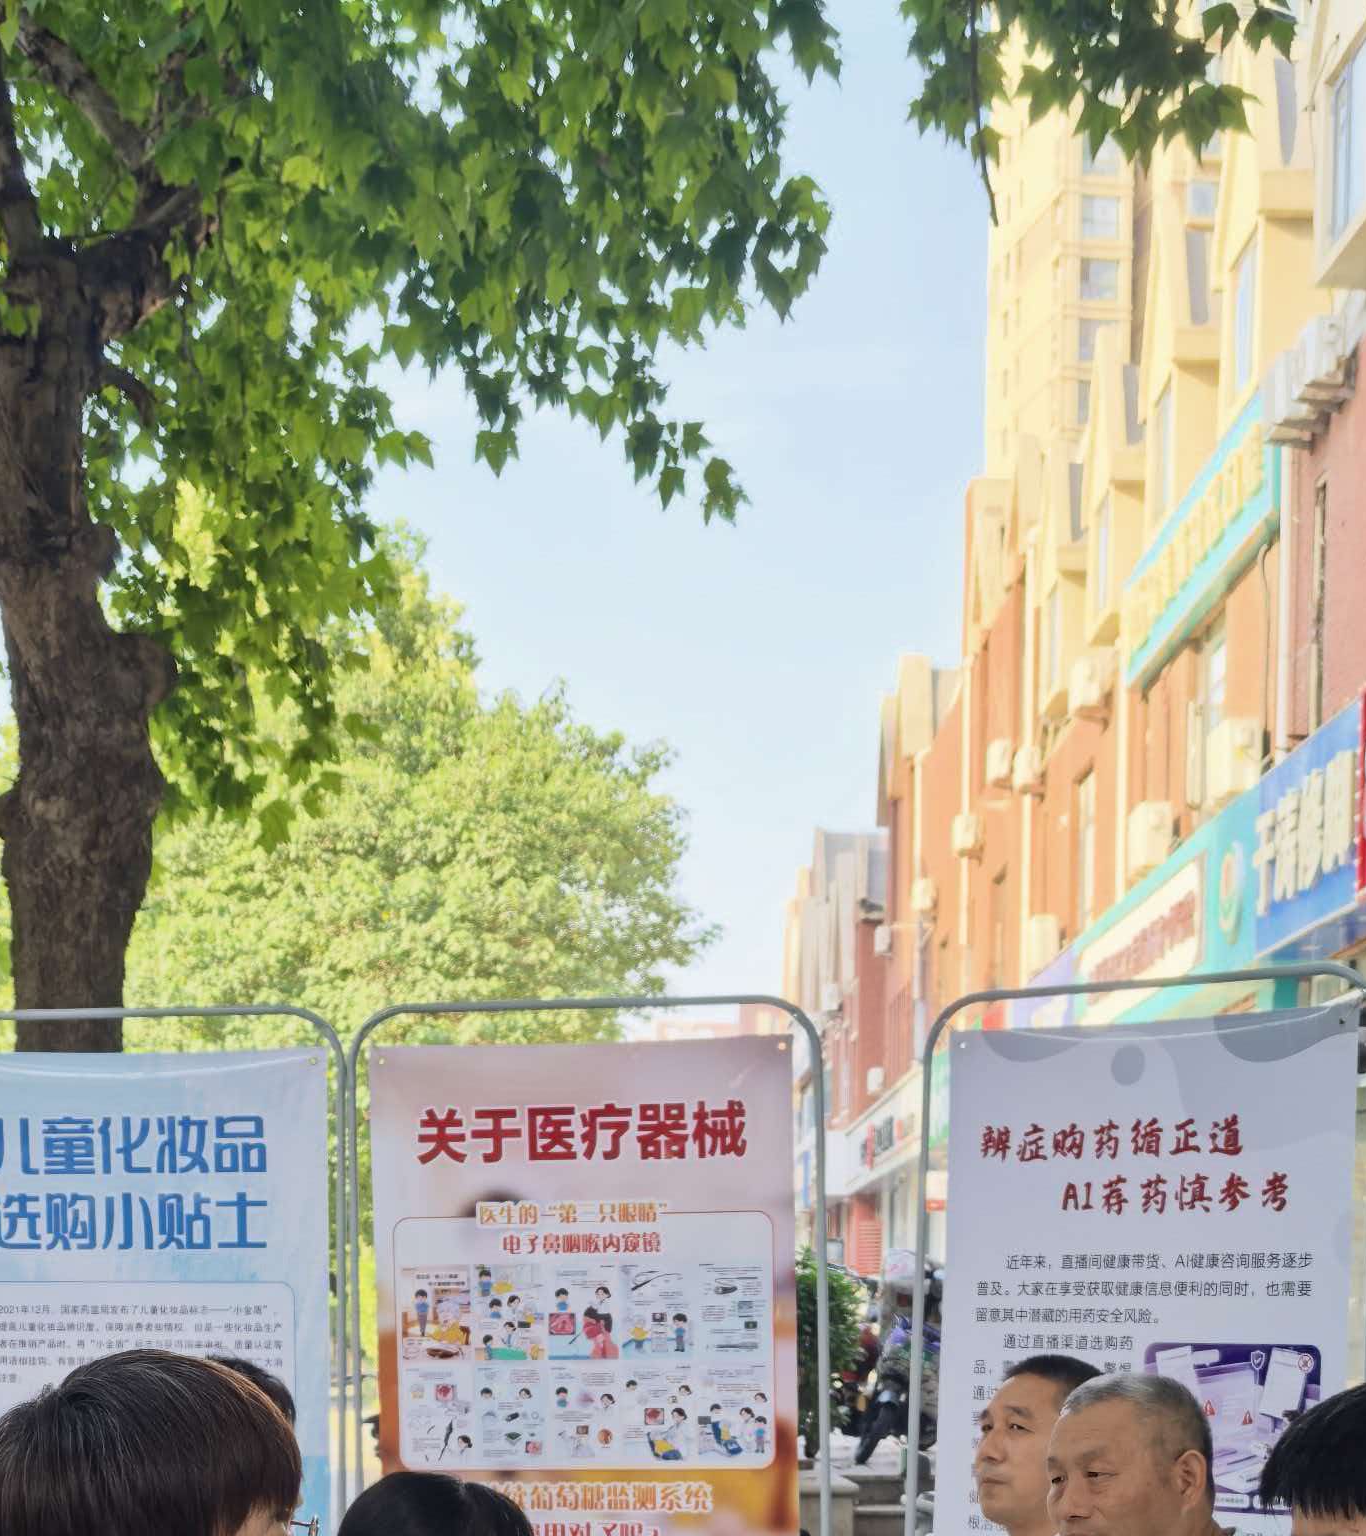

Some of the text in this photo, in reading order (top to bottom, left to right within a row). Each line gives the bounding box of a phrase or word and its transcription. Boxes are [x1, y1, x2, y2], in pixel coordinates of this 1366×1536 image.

[416, 1100, 747, 1165] 关于医疗器械
[979, 1113, 1244, 1163] 辨症购药循正道
[1060, 1172, 1293, 1216] AI荐药慎参考
[1003, 1333, 1134, 1351] 通过直播渠道选购药
